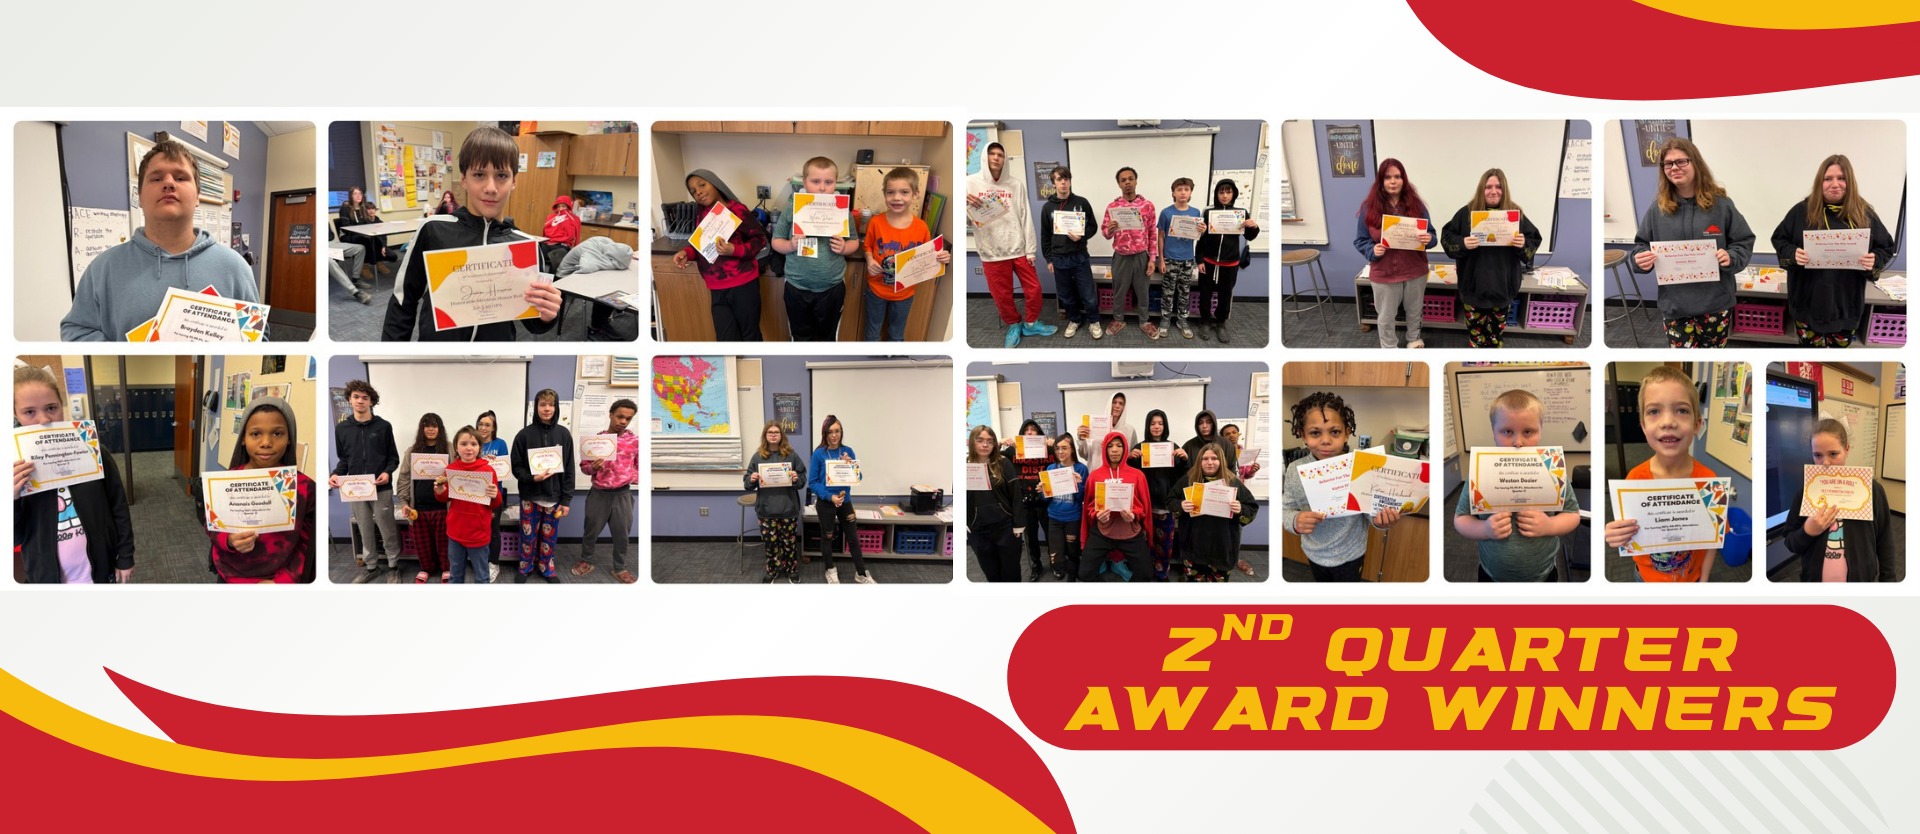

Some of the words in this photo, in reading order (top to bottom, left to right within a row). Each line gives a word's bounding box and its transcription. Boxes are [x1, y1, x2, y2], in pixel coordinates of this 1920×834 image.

[190, 304, 232, 317] CERTIFICATE
[192, 310, 236, 324] ATTENDANCE
[180, 324, 204, 335] Brayden
[205, 331, 224, 340] Kelley
[39, 432, 75, 440] CERTIFICATE
[1653, 499, 1700, 507] ATTENDANCE
